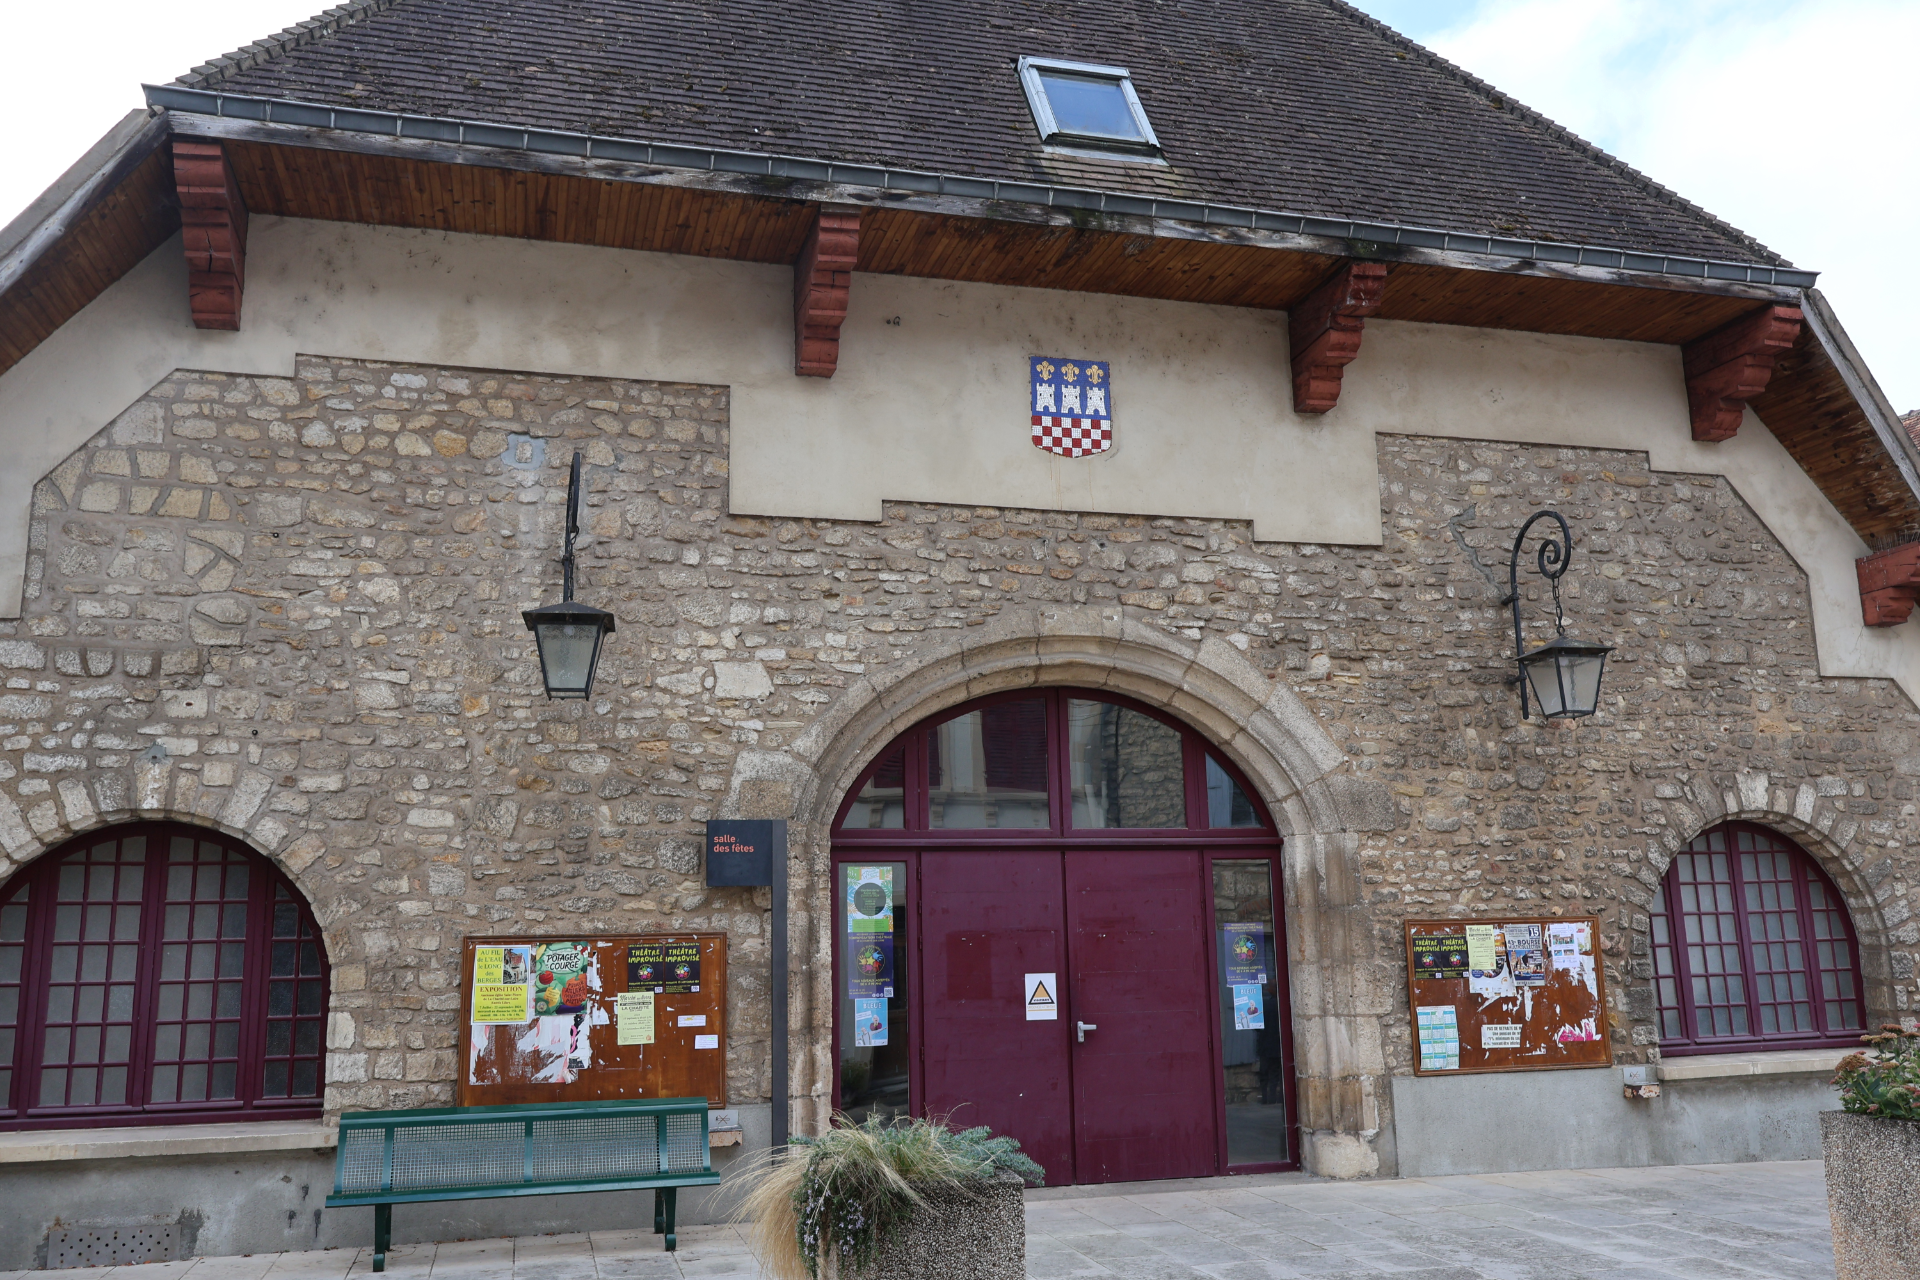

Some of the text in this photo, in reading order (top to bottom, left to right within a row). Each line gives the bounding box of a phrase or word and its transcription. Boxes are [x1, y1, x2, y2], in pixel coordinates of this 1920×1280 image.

[713, 834, 736, 843] salle
[713, 843, 755, 853] des fêtes
[1530, 928, 1539, 937] 15
[628, 955, 663, 963] IMPROVISÉ
[665, 954, 700, 963] IMPROVISÉ
[550, 961, 579, 971] COURGE
